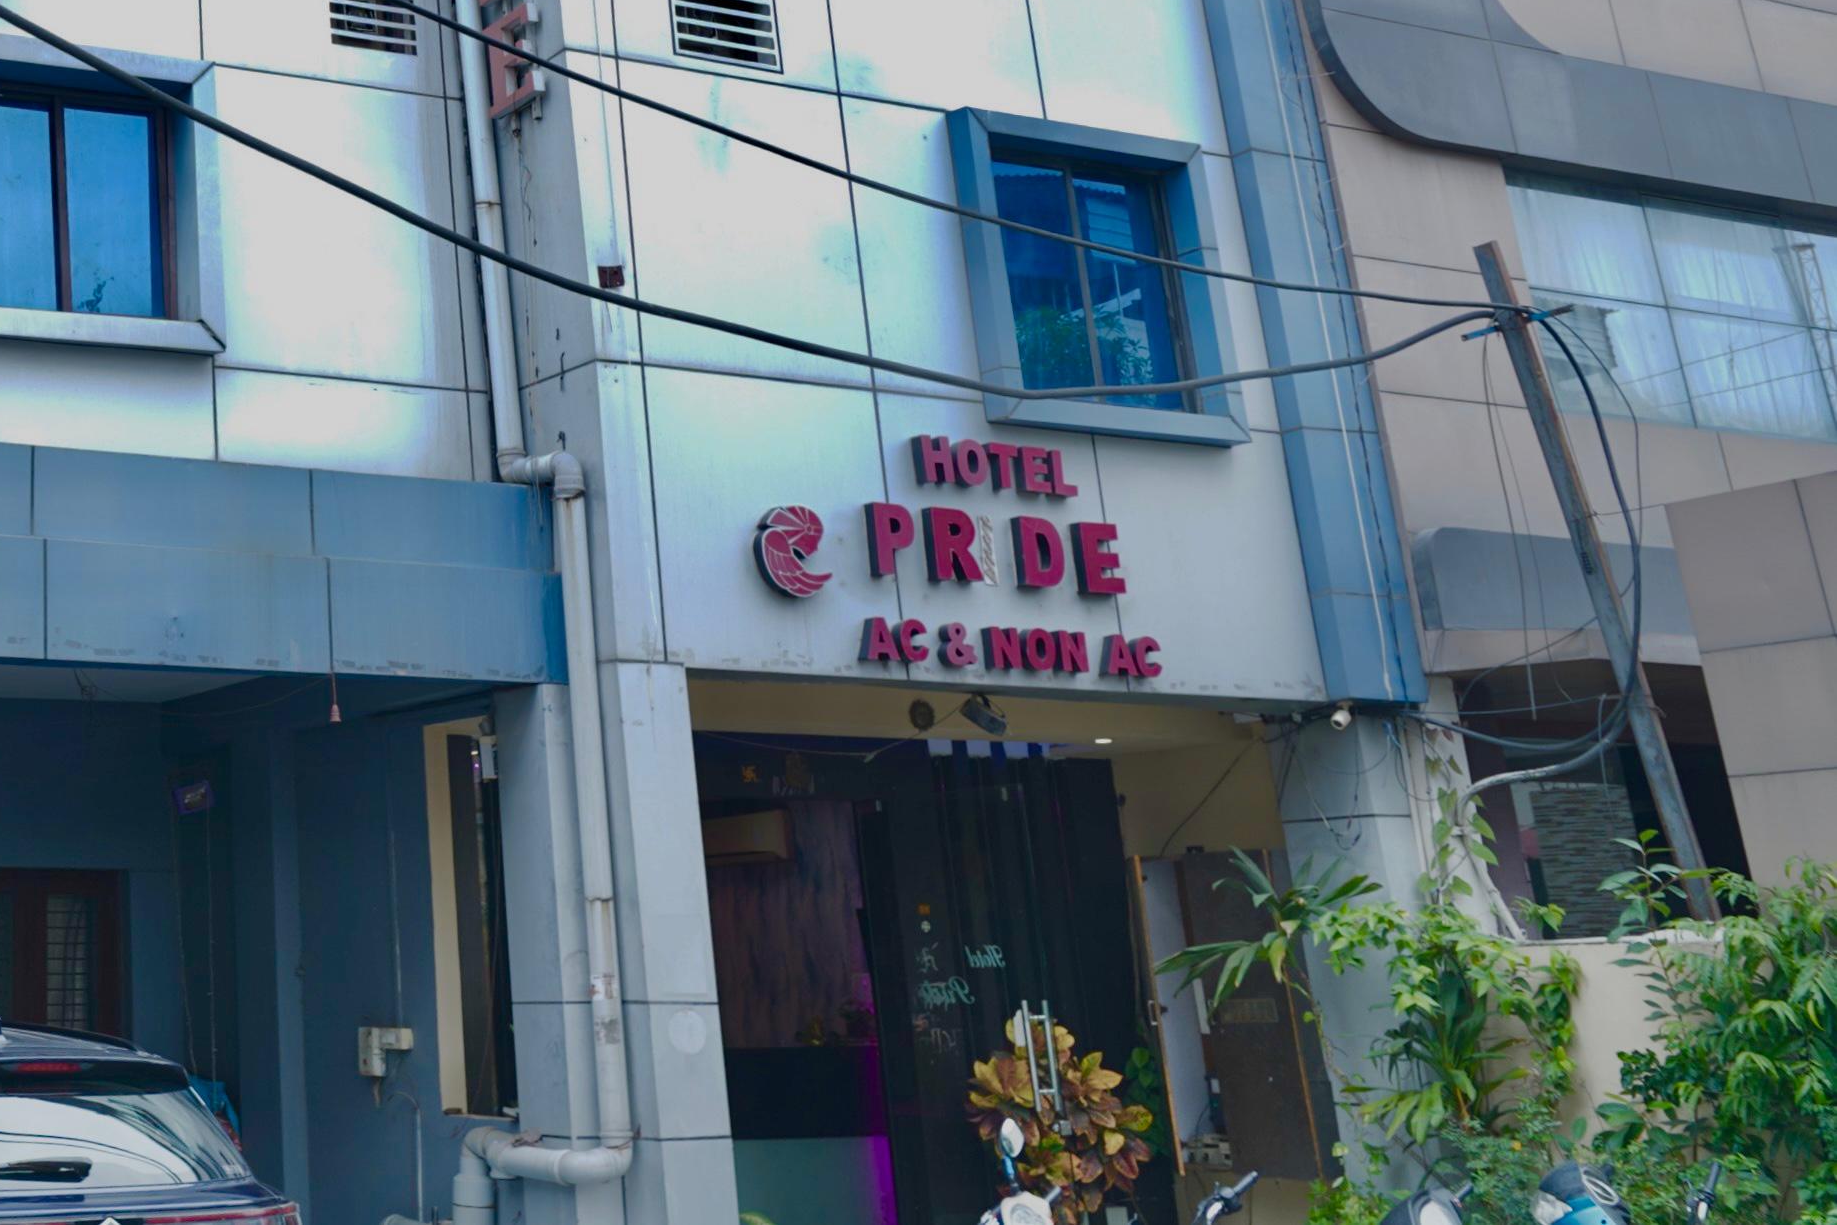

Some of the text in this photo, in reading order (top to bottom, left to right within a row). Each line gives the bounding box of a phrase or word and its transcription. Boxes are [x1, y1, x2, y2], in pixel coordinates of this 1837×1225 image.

[910, 434, 1078, 498] HOTEL
[863, 501, 1126, 595] PRIDE
[859, 616, 1163, 678] AC & NON AC
